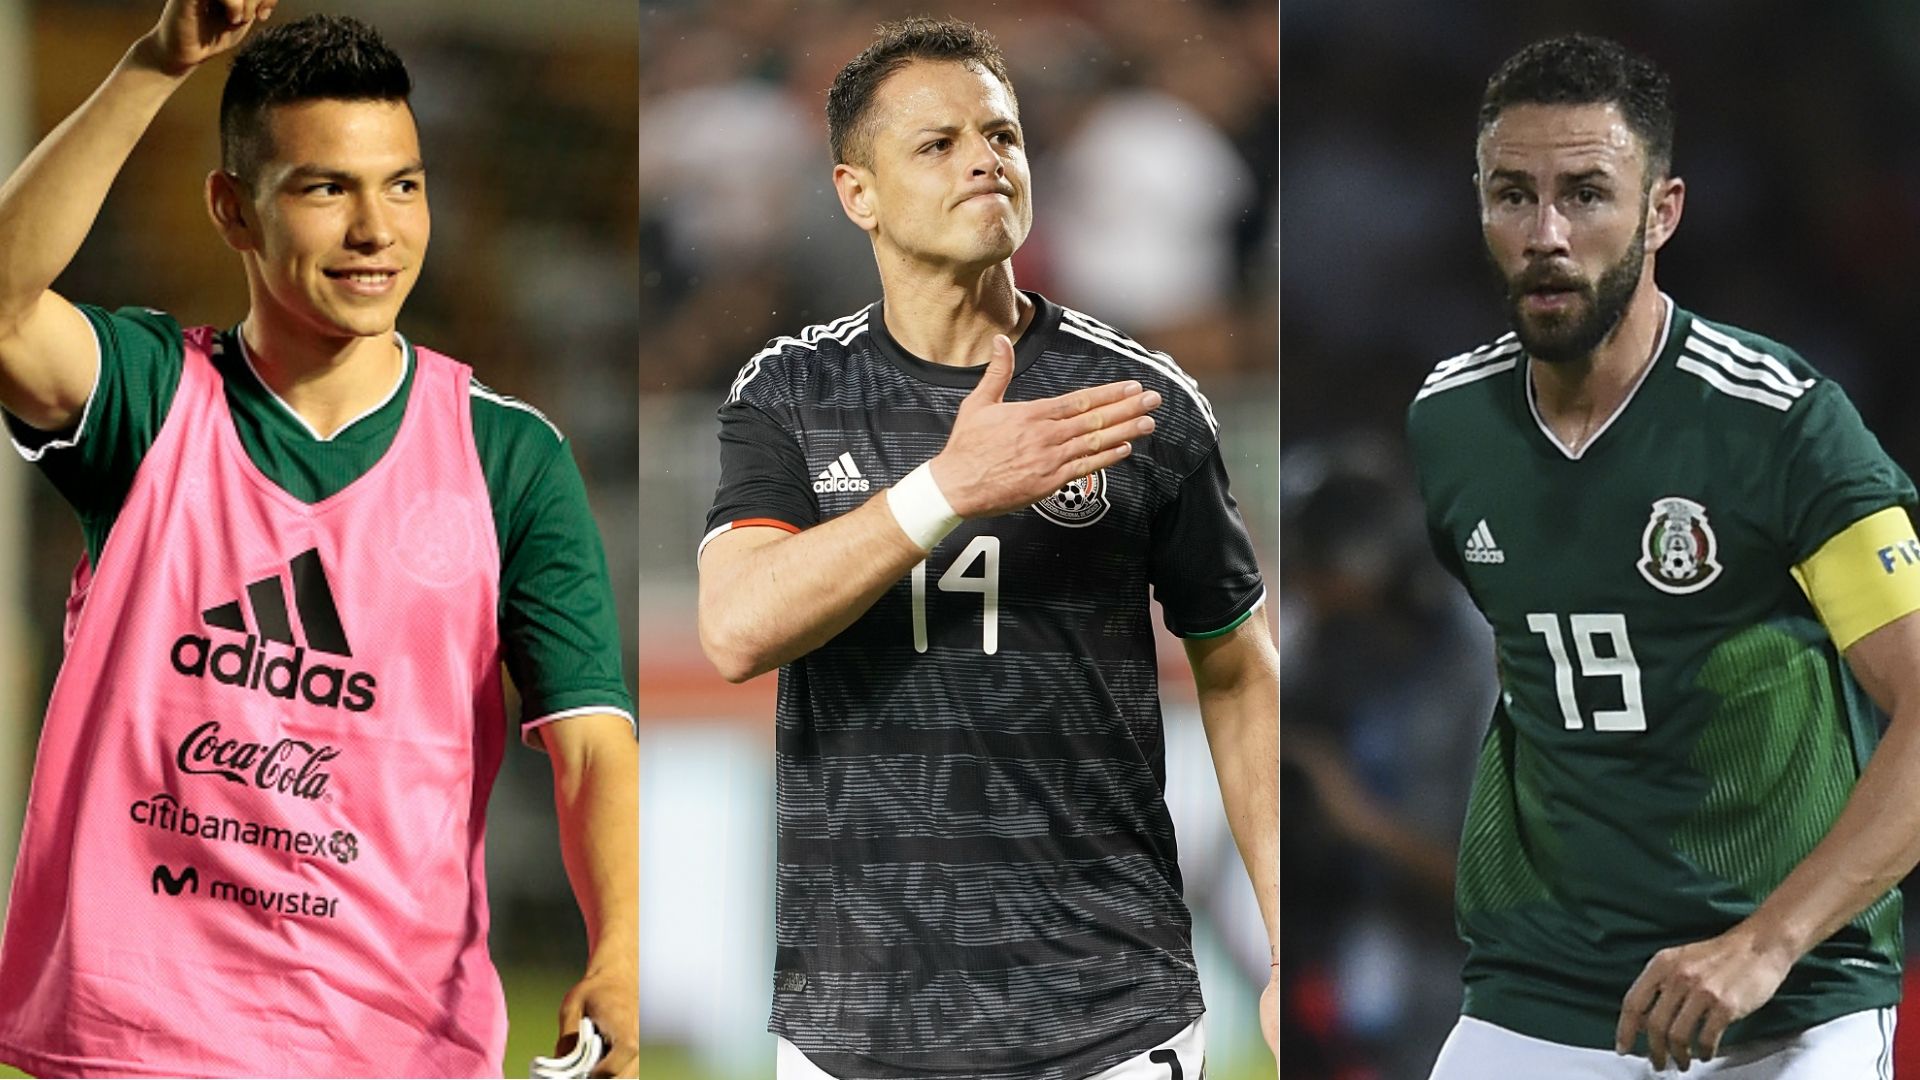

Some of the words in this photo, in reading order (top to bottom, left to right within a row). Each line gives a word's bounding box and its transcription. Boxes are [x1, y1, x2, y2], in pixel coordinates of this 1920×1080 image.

[813, 475, 870, 493] adidas
[1464, 548, 1505, 564] adidas
[911, 535, 1001, 655] 14
[170, 633, 376, 712] adidas
[1526, 612, 1647, 731] 19
[129, 793, 327, 859] citibanamex
[210, 878, 339, 918] movistar
